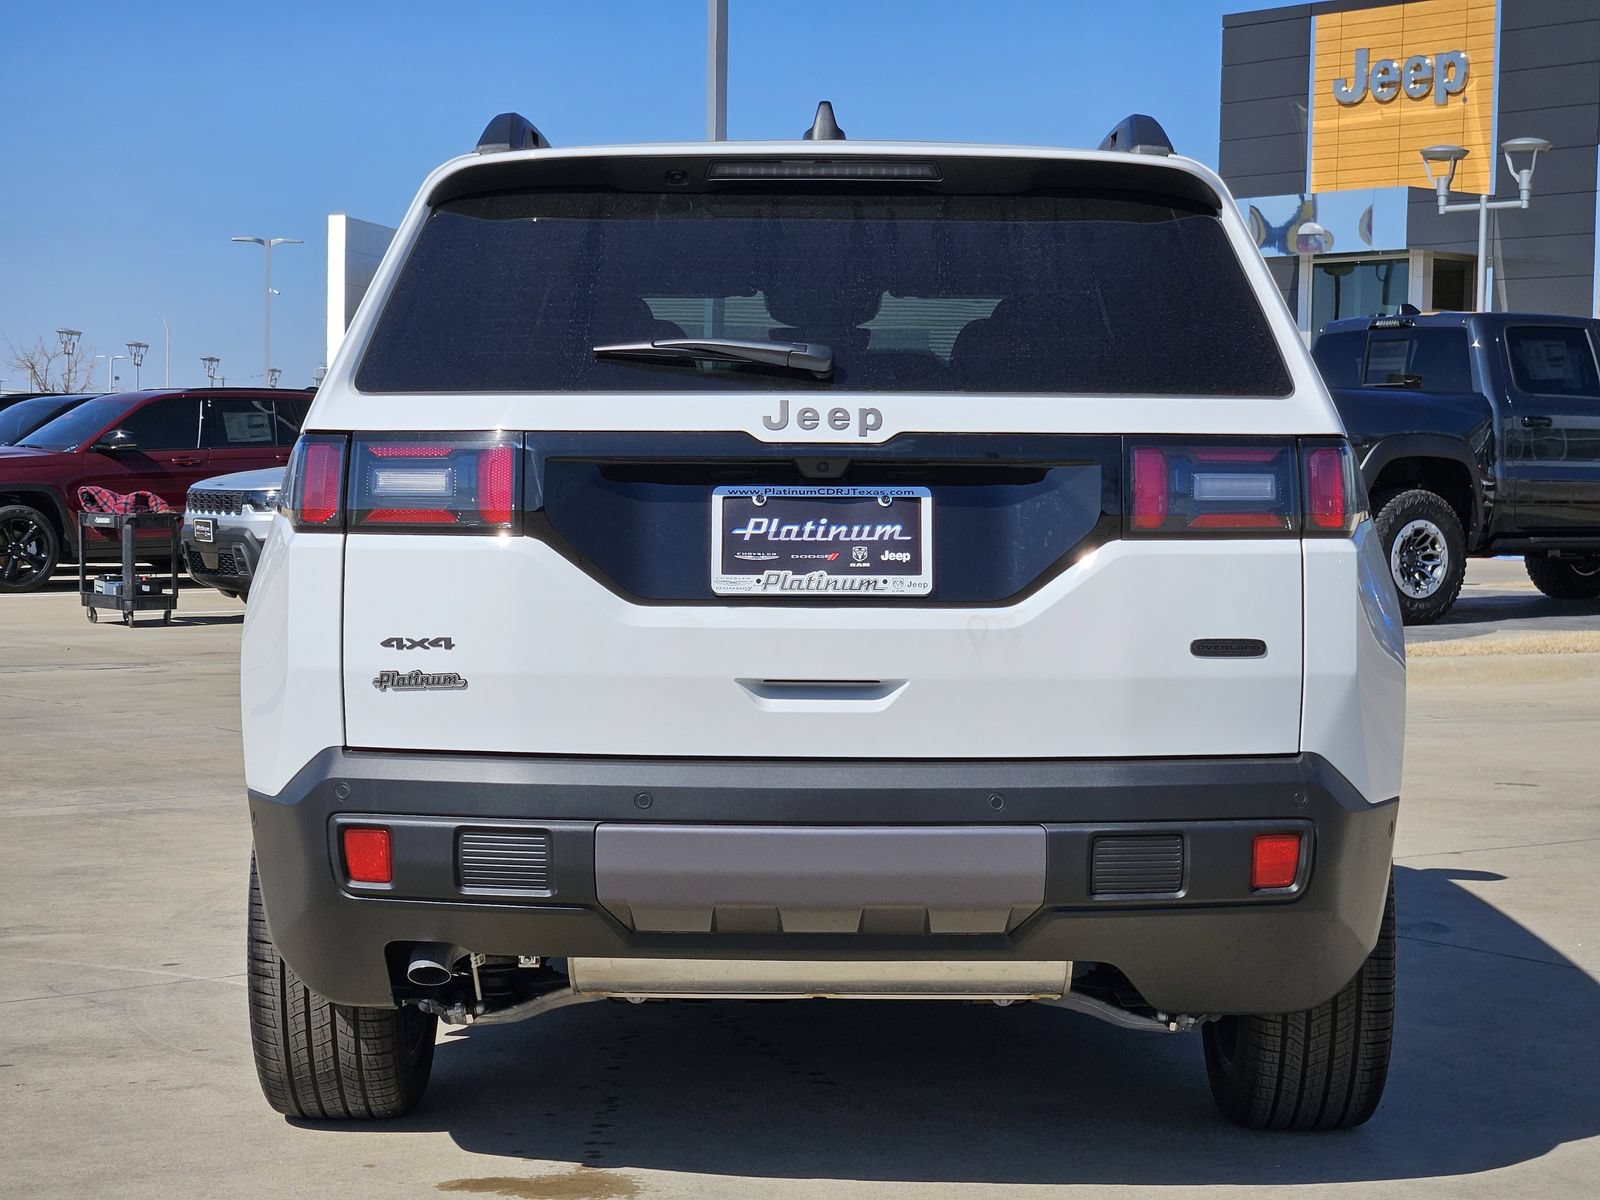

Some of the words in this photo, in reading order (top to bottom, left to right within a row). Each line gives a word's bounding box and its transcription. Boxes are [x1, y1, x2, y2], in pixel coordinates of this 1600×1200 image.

[1332, 47, 1470, 107] Jeep
[762, 399, 883, 437] Jeep
[728, 487, 915, 496] www.PlatinumCDRJTexas.com
[732, 518, 912, 541] Platinum
[880, 550, 911, 563] Jeep
[762, 573, 889, 592] Platinum
[907, 581, 929, 590] Jeep
[373, 670, 468, 691] Platinum
